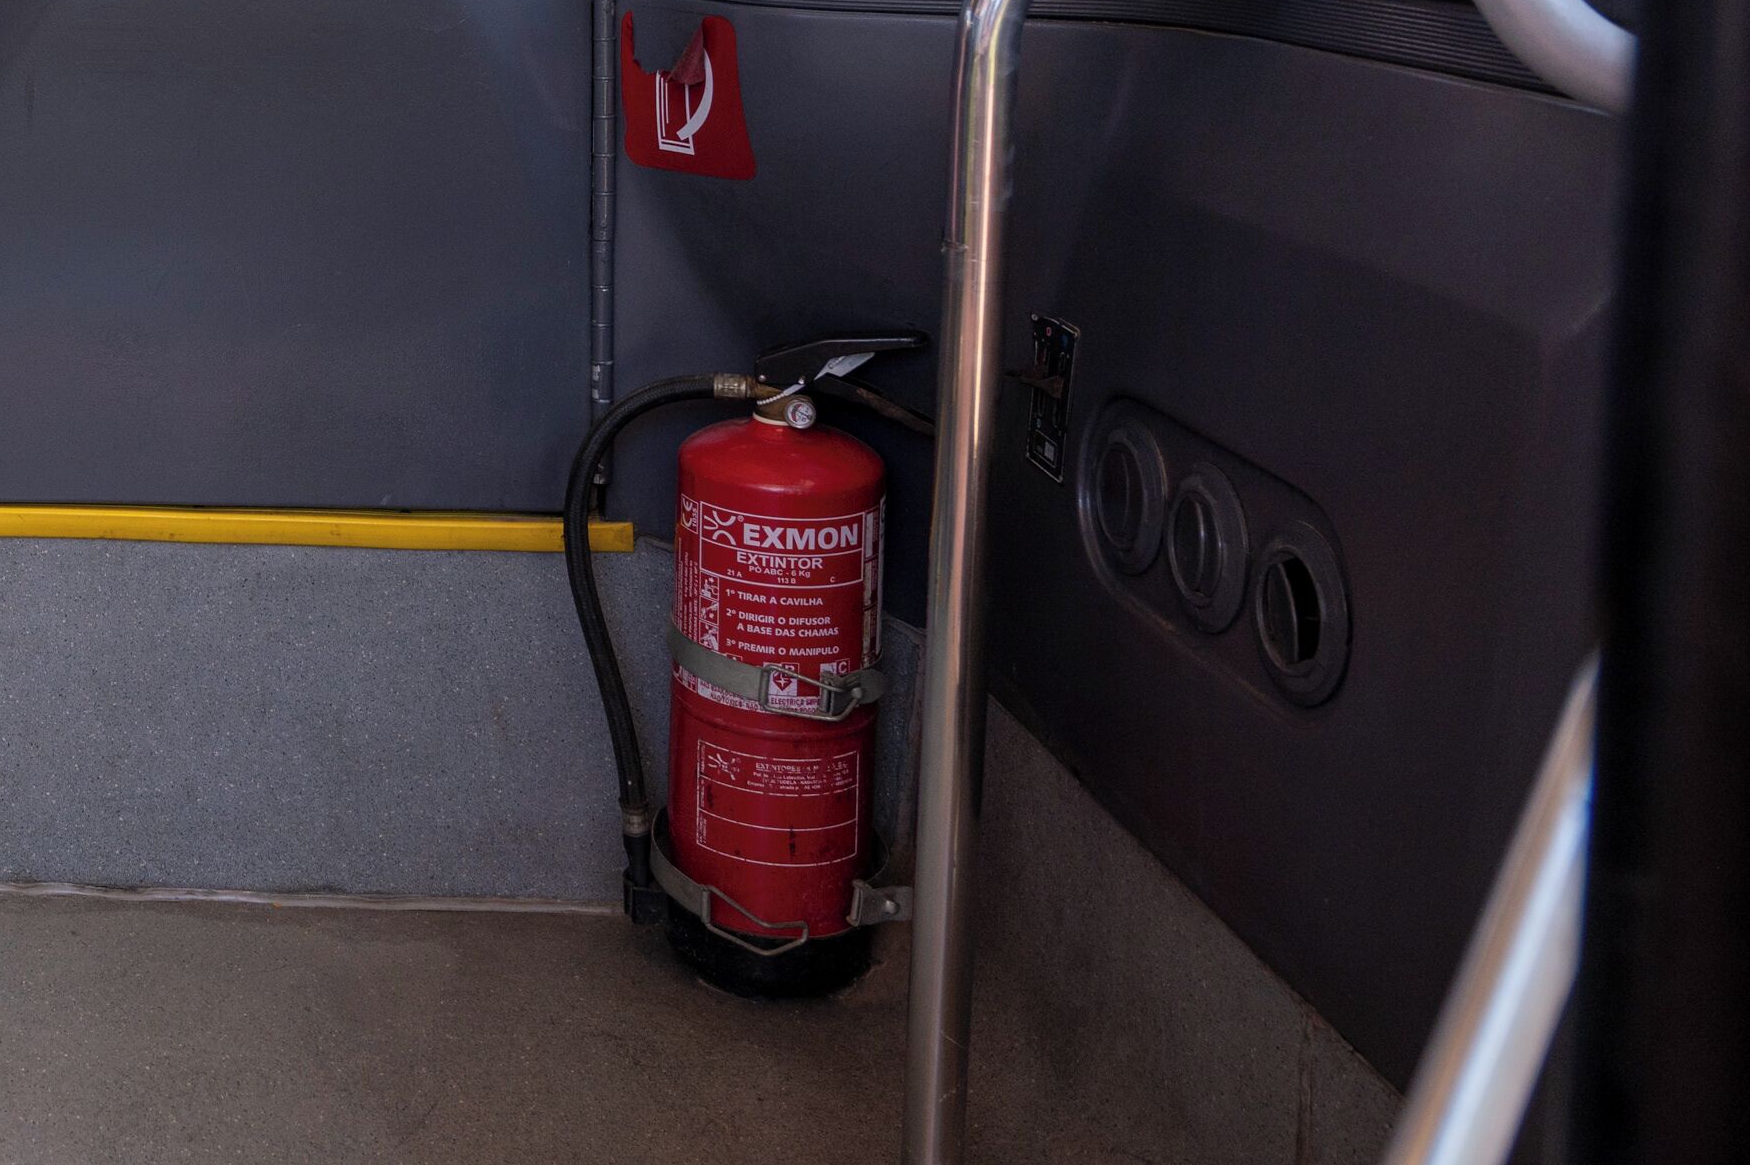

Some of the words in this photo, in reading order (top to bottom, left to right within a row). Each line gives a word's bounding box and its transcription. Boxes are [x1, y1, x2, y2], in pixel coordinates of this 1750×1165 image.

[743, 523, 858, 550] EXMON
[736, 552, 823, 570] EXTINTOR
[763, 568, 784, 576] ABC
[791, 569, 797, 577] 6
[798, 570, 811, 578] Kg
[737, 591, 766, 604] TIRAR
[769, 596, 778, 605] A
[780, 596, 823, 606] CAVILHA
[738, 612, 775, 624] DIRIGIR
[777, 616, 786, 625] O
[788, 616, 831, 626] DIFUSOR
[737, 623, 745, 631] A
[747, 625, 773, 636] BASE
[775, 628, 796, 637] DAS
[797, 626, 839, 637] CHAMAS
[738, 641, 775, 655] PREMIR
[778, 647, 786, 655] O
[789, 645, 839, 656] MANIPULO
[837, 661, 847, 674] C
